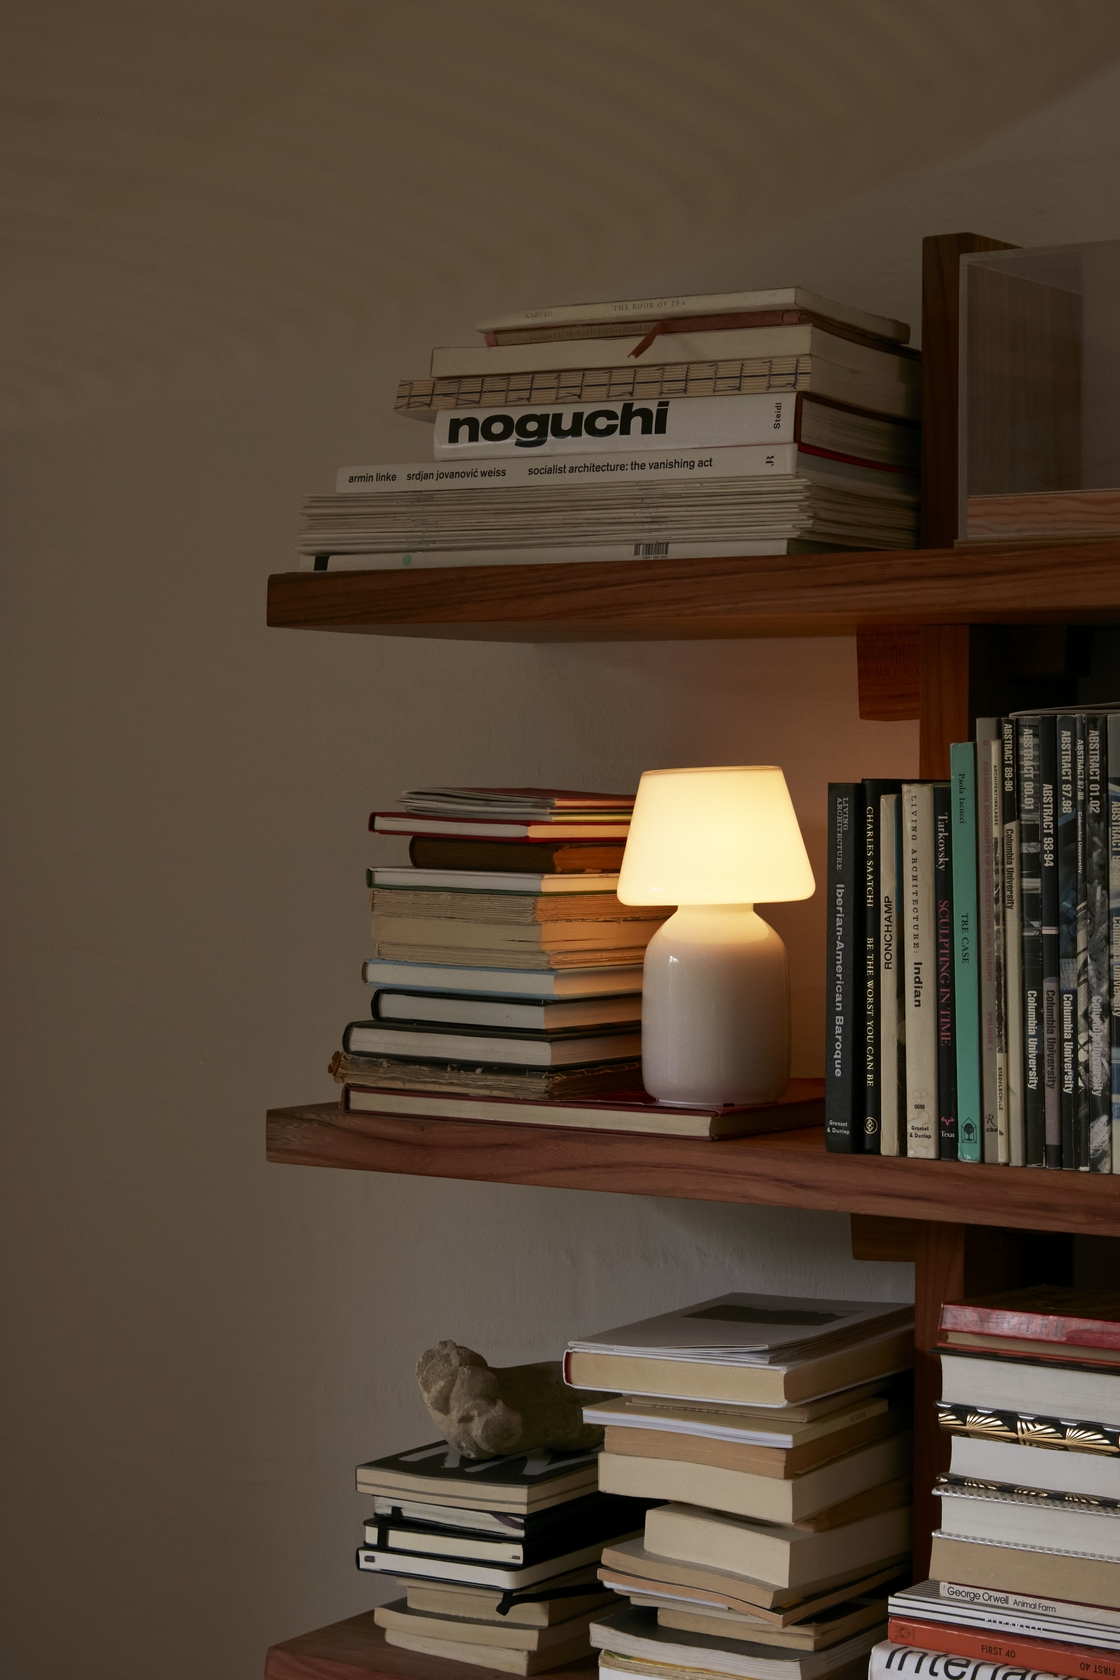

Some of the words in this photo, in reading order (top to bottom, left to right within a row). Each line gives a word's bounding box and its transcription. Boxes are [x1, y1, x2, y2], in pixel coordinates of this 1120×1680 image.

[614, 304, 629, 312] THE
[632, 302, 654, 310] BOOK
[448, 400, 670, 448] noguchi
[773, 402, 782, 429] Steidl
[348, 473, 374, 484] armin
[376, 472, 397, 483] linke
[406, 469, 434, 482] srdjan
[435, 467, 478, 482] jovanović
[480, 467, 506, 478] weiss
[528, 464, 567, 476] socialist
[568, 461, 628, 474] architecture:
[630, 460, 646, 471] the
[648, 458, 695, 471] vanishing
[697, 457, 713, 469] act
[1004, 724, 1013, 765] ABSTRACT
[1023, 728, 1034, 778] ABSTRACT
[1062, 730, 1072, 782] ABSTRACT
[1089, 730, 1100, 781] ABSTRACT
[958, 773, 966, 794] Paola
[1004, 767, 1014, 792] 89-90
[1024, 782, 1034, 810] 00.01
[1062, 784, 1072, 814] 97.98
[1090, 784, 1100, 814] 01.02
[1042, 783, 1053, 835] ABSTRACT
[1112, 801, 1120, 851] ABSTRACT
[866, 806, 874, 857] CHARLES
[936, 812, 949, 872] Tarkovsky
[1006, 828, 1014, 865] Columbia
[985, 852, 990, 866] OF
[1044, 837, 1054, 868] 93-94
[866, 860, 874, 908] SAATCHI
[912, 848, 920, 954] ARCHITECTURE:
[1006, 867, 1014, 910] University
[835, 884, 845, 1011] Iberian-American
[866, 937, 874, 950] BE
[884, 896, 892, 970] RONCHAMP
[939, 900, 950, 984] SCULPTING
[962, 937, 970, 964] CASE
[1112, 916, 1120, 962] Columbia
[866, 954, 874, 976] THE
[866, 980, 874, 1016] WORST
[914, 962, 923, 1008] Indian
[940, 988, 950, 1003] IN
[1112, 965, 1120, 1017] University
[866, 1020, 874, 1043] YOU
[940, 1008, 951, 1046] TIME
[1028, 990, 1038, 1035] Columbia
[1046, 990, 1056, 1034] Columbia
[1063, 994, 1073, 1040] Columbia
[1092, 996, 1102, 1041] Columbia
[833, 1015, 844, 1077] Baroque
[866, 1046, 874, 1070] CAN
[1028, 1038, 1038, 1090] University
[1046, 1038, 1056, 1090] University
[866, 1074, 874, 1087] BE
[1063, 1042, 1074, 1094] University
[1092, 1043, 1103, 1096] University
[940, 1130, 955, 1138] Texas
[947, 1586, 980, 1601] George
[982, 1592, 1009, 1604] Orwell
[1012, 1599, 1037, 1610] Animal
[1038, 1603, 1056, 1613] Farm
[981, 1644, 1002, 1656] FIRST
[1005, 1649, 1016, 1659] 40
[1080, 1661, 1091, 1671] 40
[1093, 1664, 1116, 1676] FIRST
